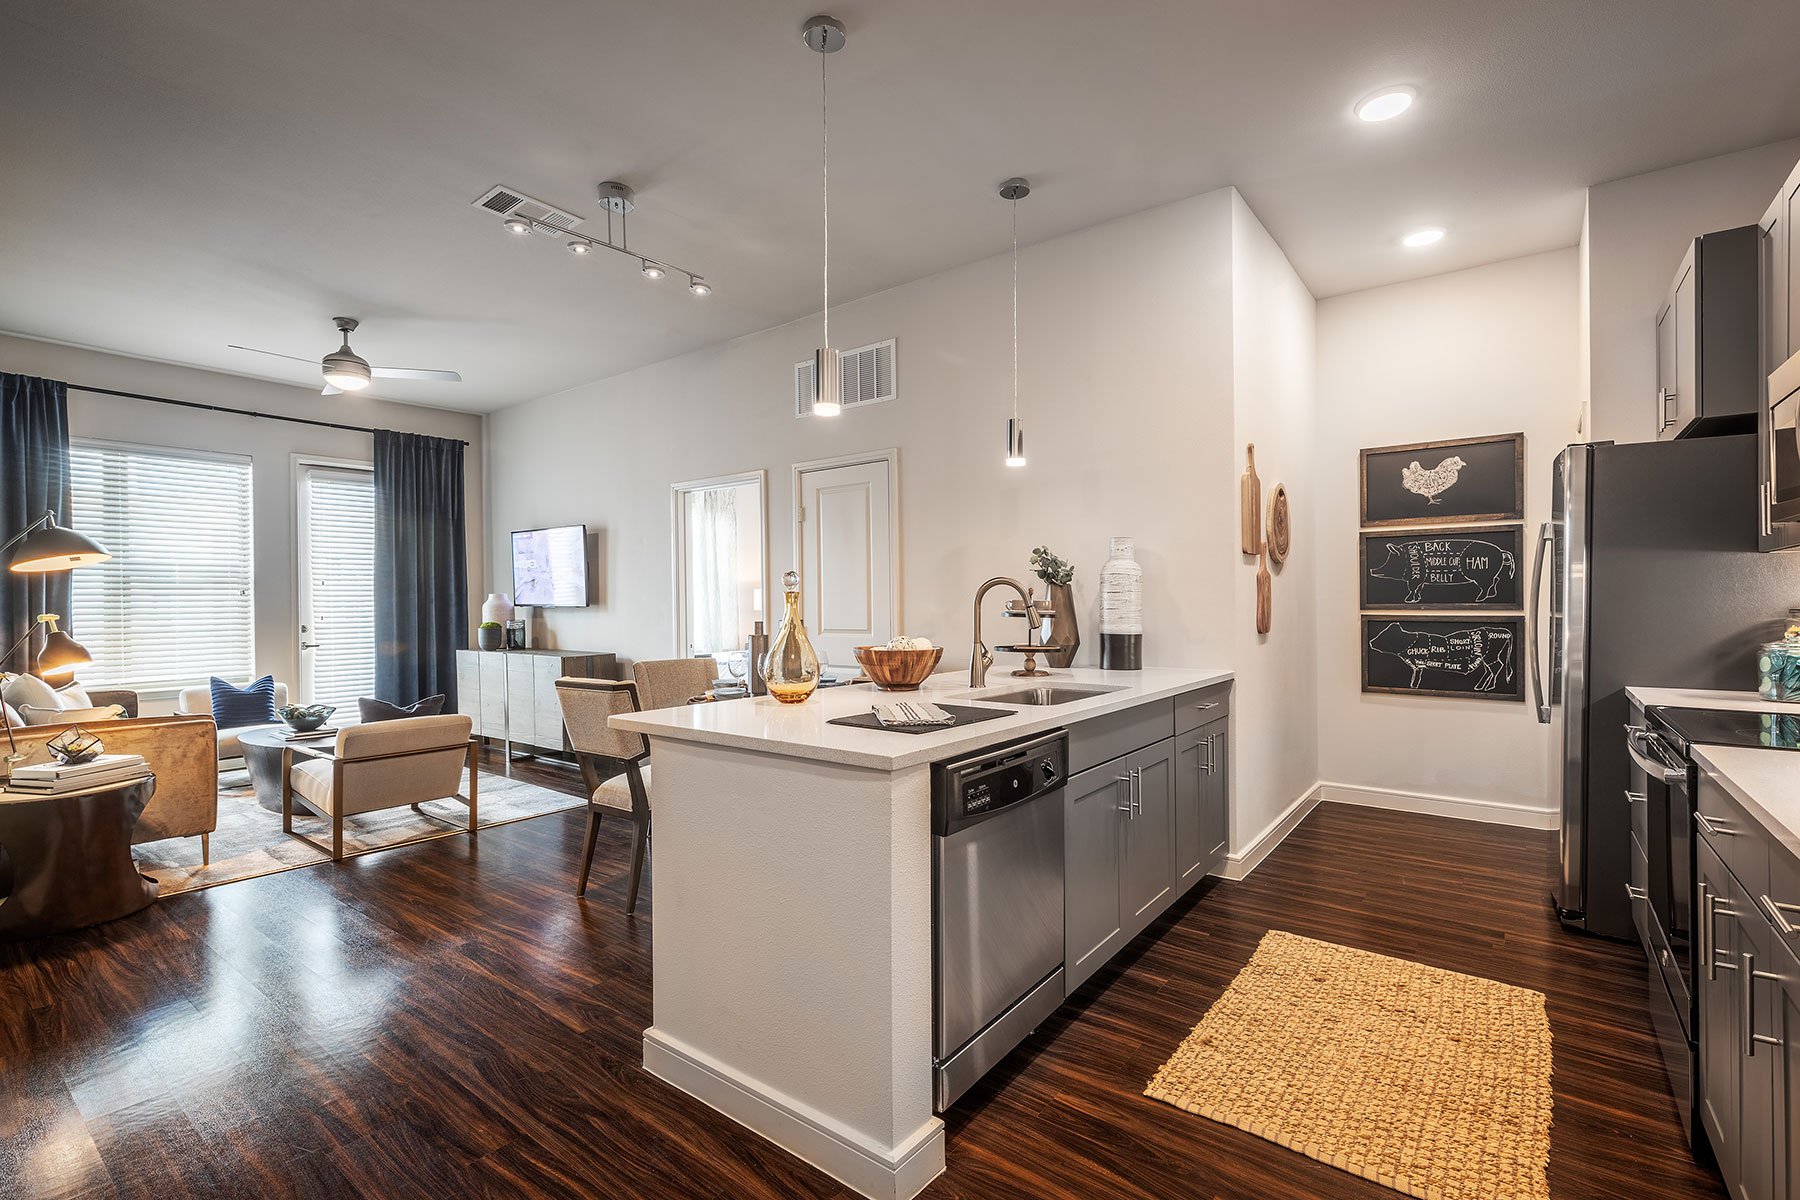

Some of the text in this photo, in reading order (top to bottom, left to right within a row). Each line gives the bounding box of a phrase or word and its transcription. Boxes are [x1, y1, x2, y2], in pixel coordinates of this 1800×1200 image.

[1425, 542, 1451, 551] BACK
[1426, 556, 1446, 566] MIDDLE
[1466, 557, 1489, 569] HAM
[1430, 573, 1454, 582] BELLY
[1407, 647, 1429, 656] CHUCK
[1445, 662, 1461, 670] PLATE
